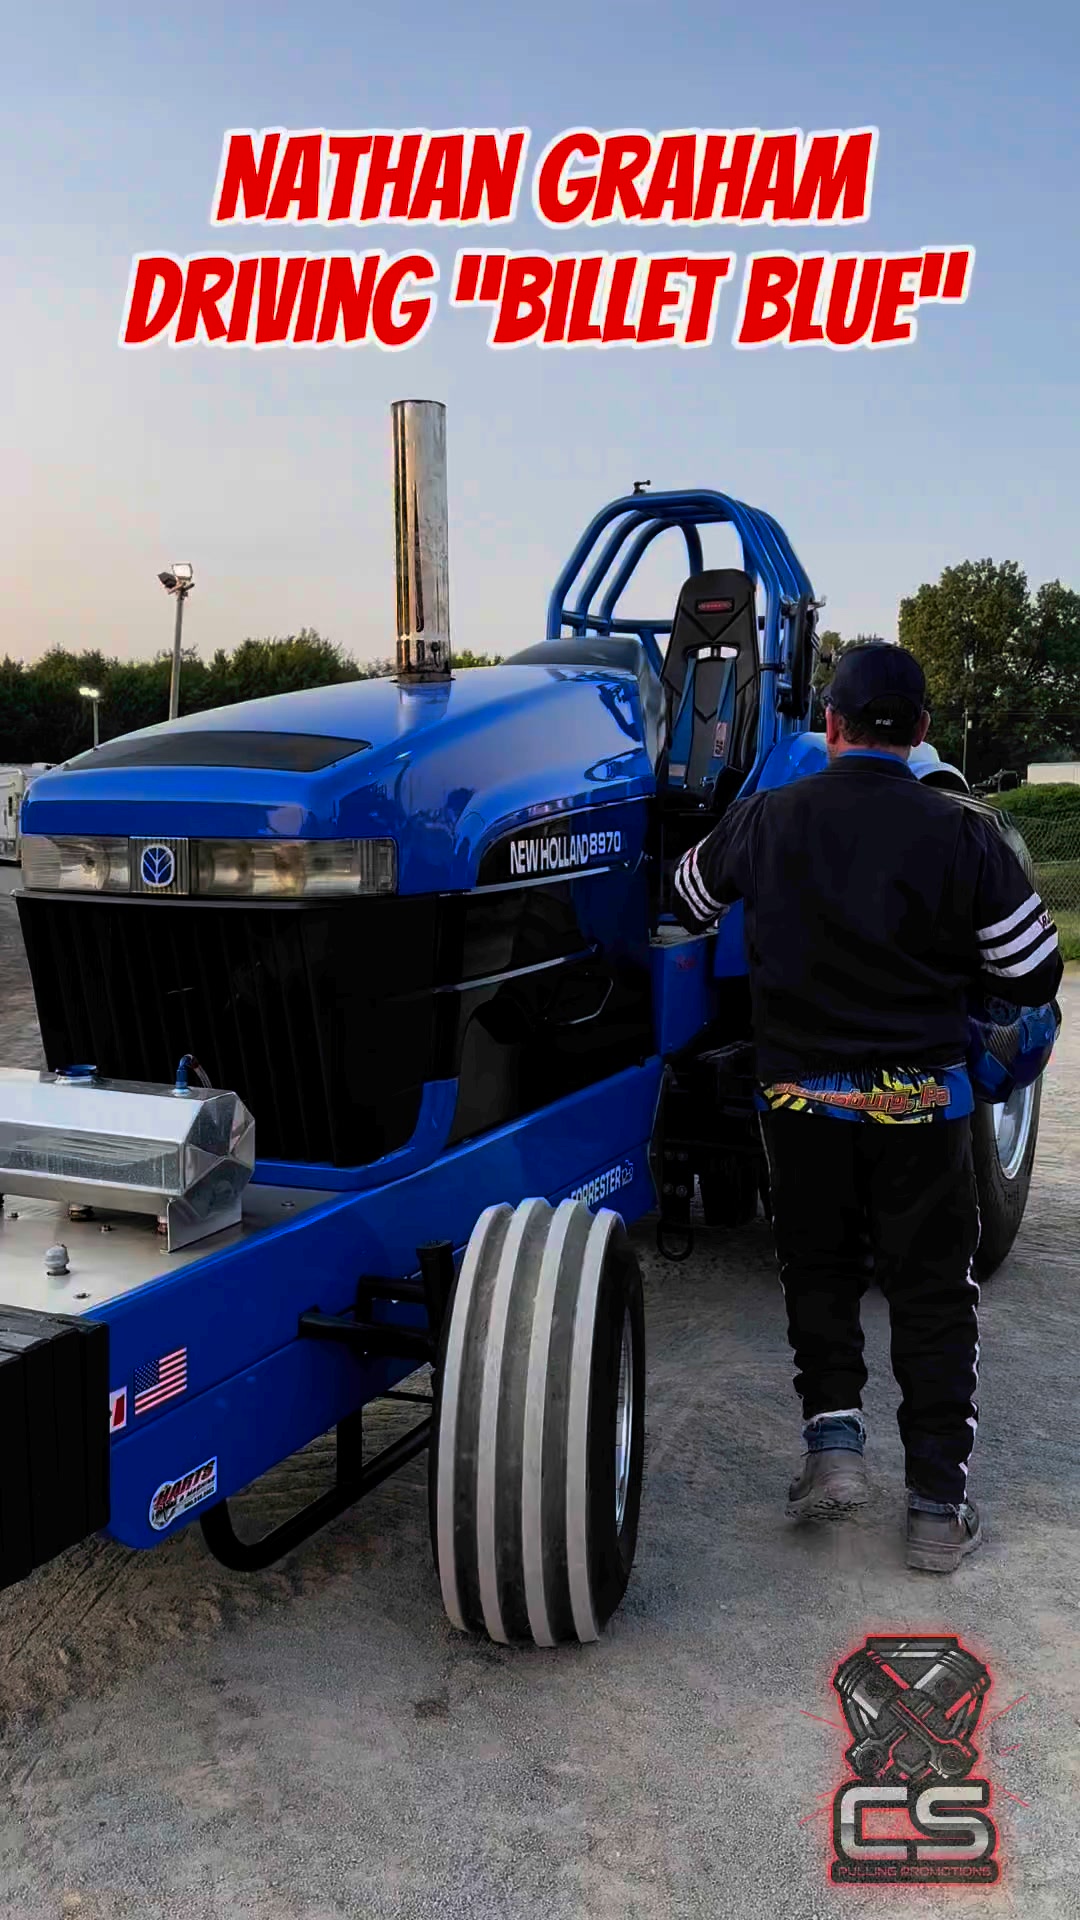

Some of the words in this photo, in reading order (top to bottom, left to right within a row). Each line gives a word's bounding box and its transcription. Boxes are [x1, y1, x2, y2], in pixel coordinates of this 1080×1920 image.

[510, 839, 539, 874] NEW
[540, 834, 589, 871] HOLLAND
[589, 830, 621, 855] 8970
